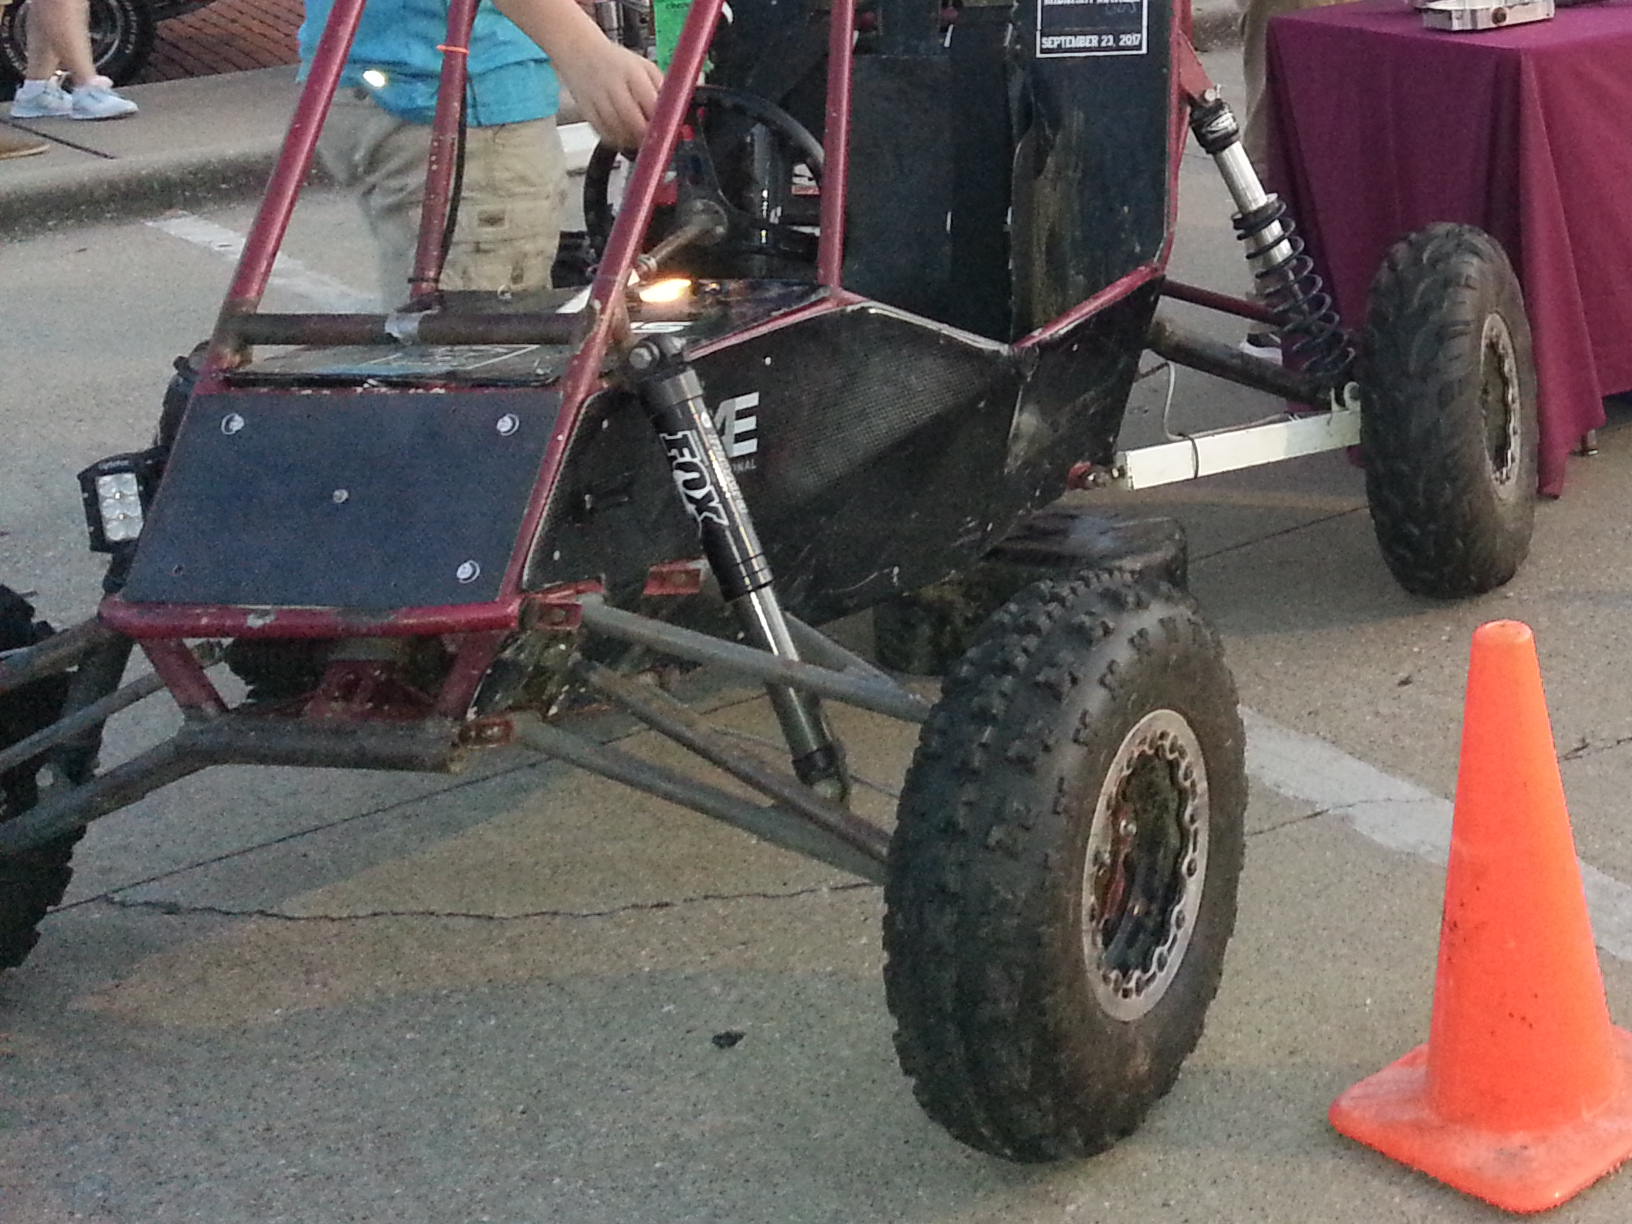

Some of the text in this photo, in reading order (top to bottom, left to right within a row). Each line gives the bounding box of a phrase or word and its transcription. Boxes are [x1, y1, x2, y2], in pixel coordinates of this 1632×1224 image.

[1041, 33, 1099, 49] SEPTEMBER
[1119, 32, 1142, 46] 2017
[660, 429, 730, 527] FOX
